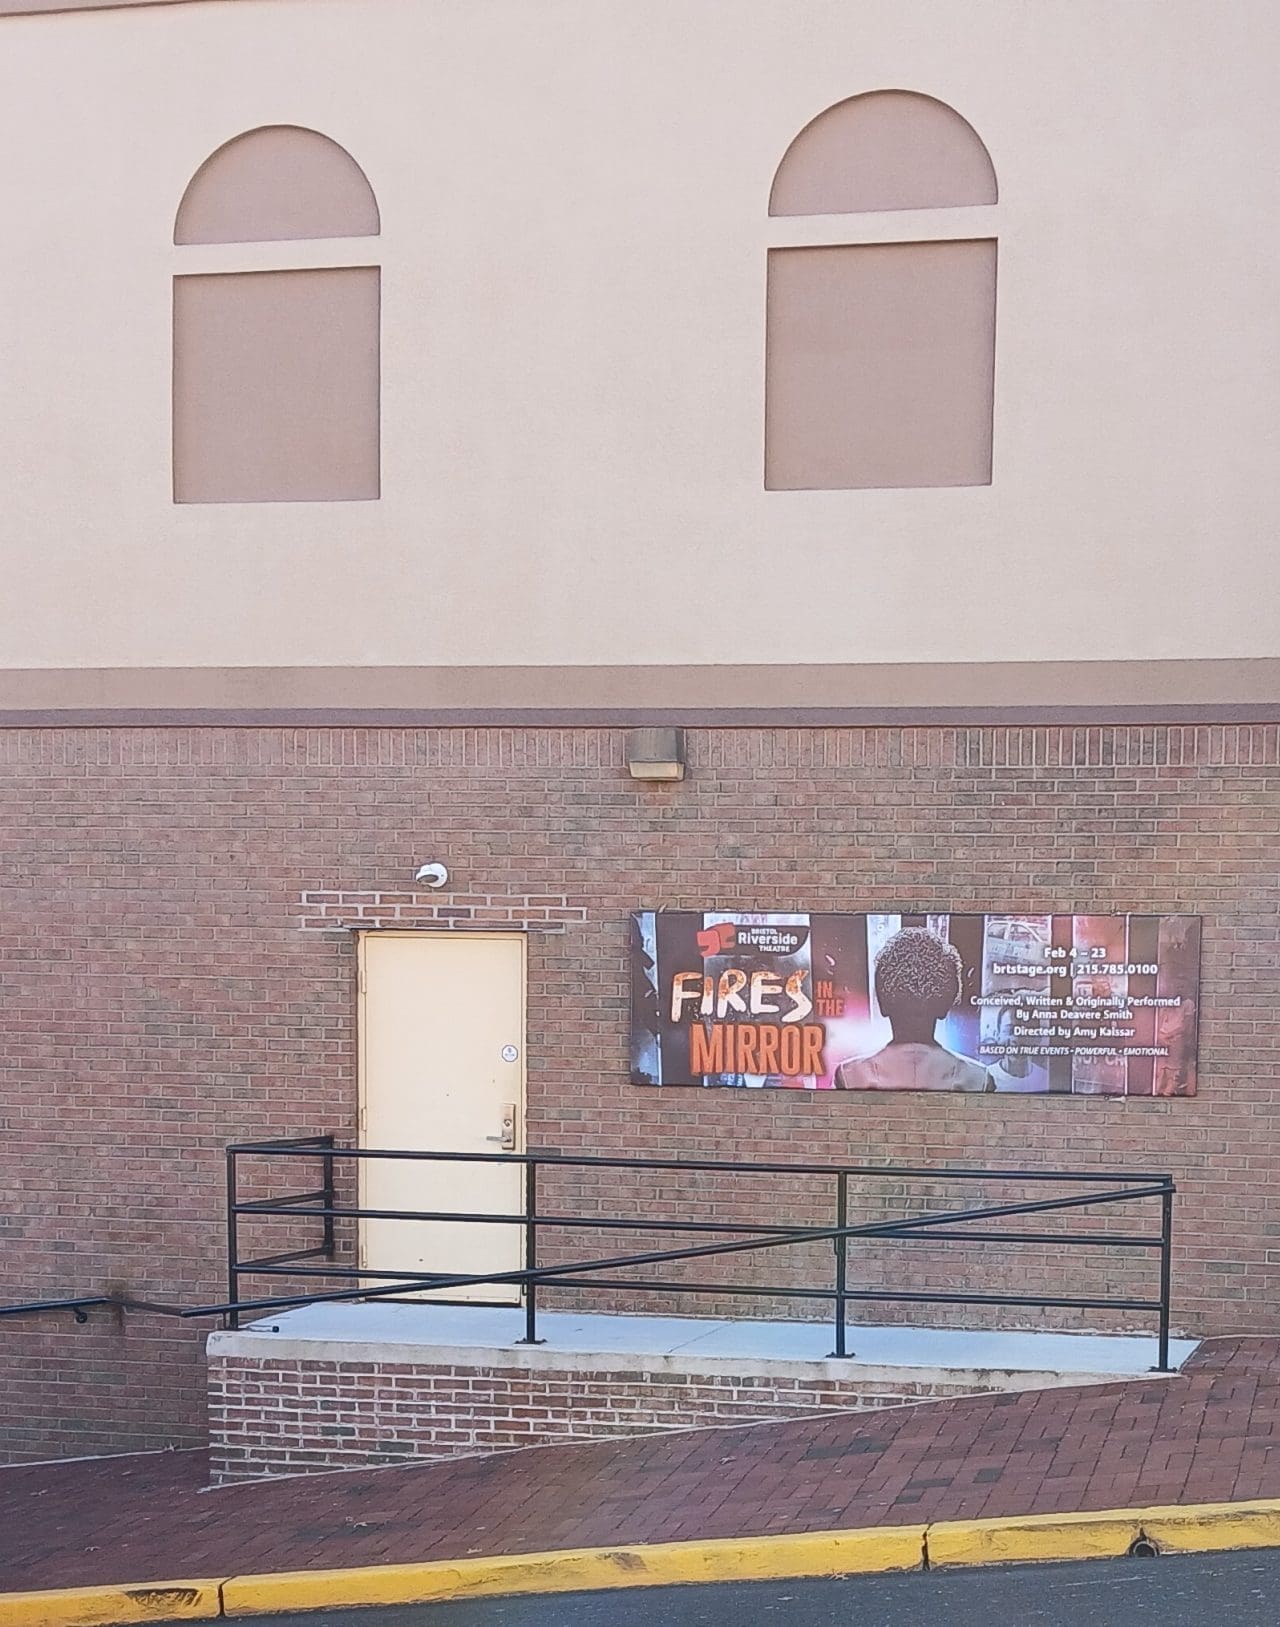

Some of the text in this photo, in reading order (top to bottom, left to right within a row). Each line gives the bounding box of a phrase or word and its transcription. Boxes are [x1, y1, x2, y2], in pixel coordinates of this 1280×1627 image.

[750, 927, 778, 935] BRISTOL
[738, 931, 798, 945] Riverside
[758, 945, 791, 953] THEATRE
[1044, 946, 1066, 958] Feb
[1069, 947, 1077, 958] 4
[1091, 947, 1107, 958] 23
[993, 963, 1067, 977] brtstage.org
[1077, 964, 1158, 975] 215.785.0100
[671, 968, 813, 1023] FIRES
[816, 981, 834, 999] IN
[816, 999, 844, 1017] THE
[970, 995, 1024, 1006] Conceived,
[1026, 996, 1063, 1006] Written
[1075, 996, 1125, 1008] Originally
[1127, 996, 1181, 1006] Performed
[1016, 1009, 1133, 1021] By Anna Deavere Smith
[1014, 1026, 1136, 1039] Directed by Amy Kaissar
[690, 1023, 826, 1077] MIRROR
[980, 1046, 1169, 1056] BASED ON TRUE EVENTS POWERFUL EMOTIONAL
